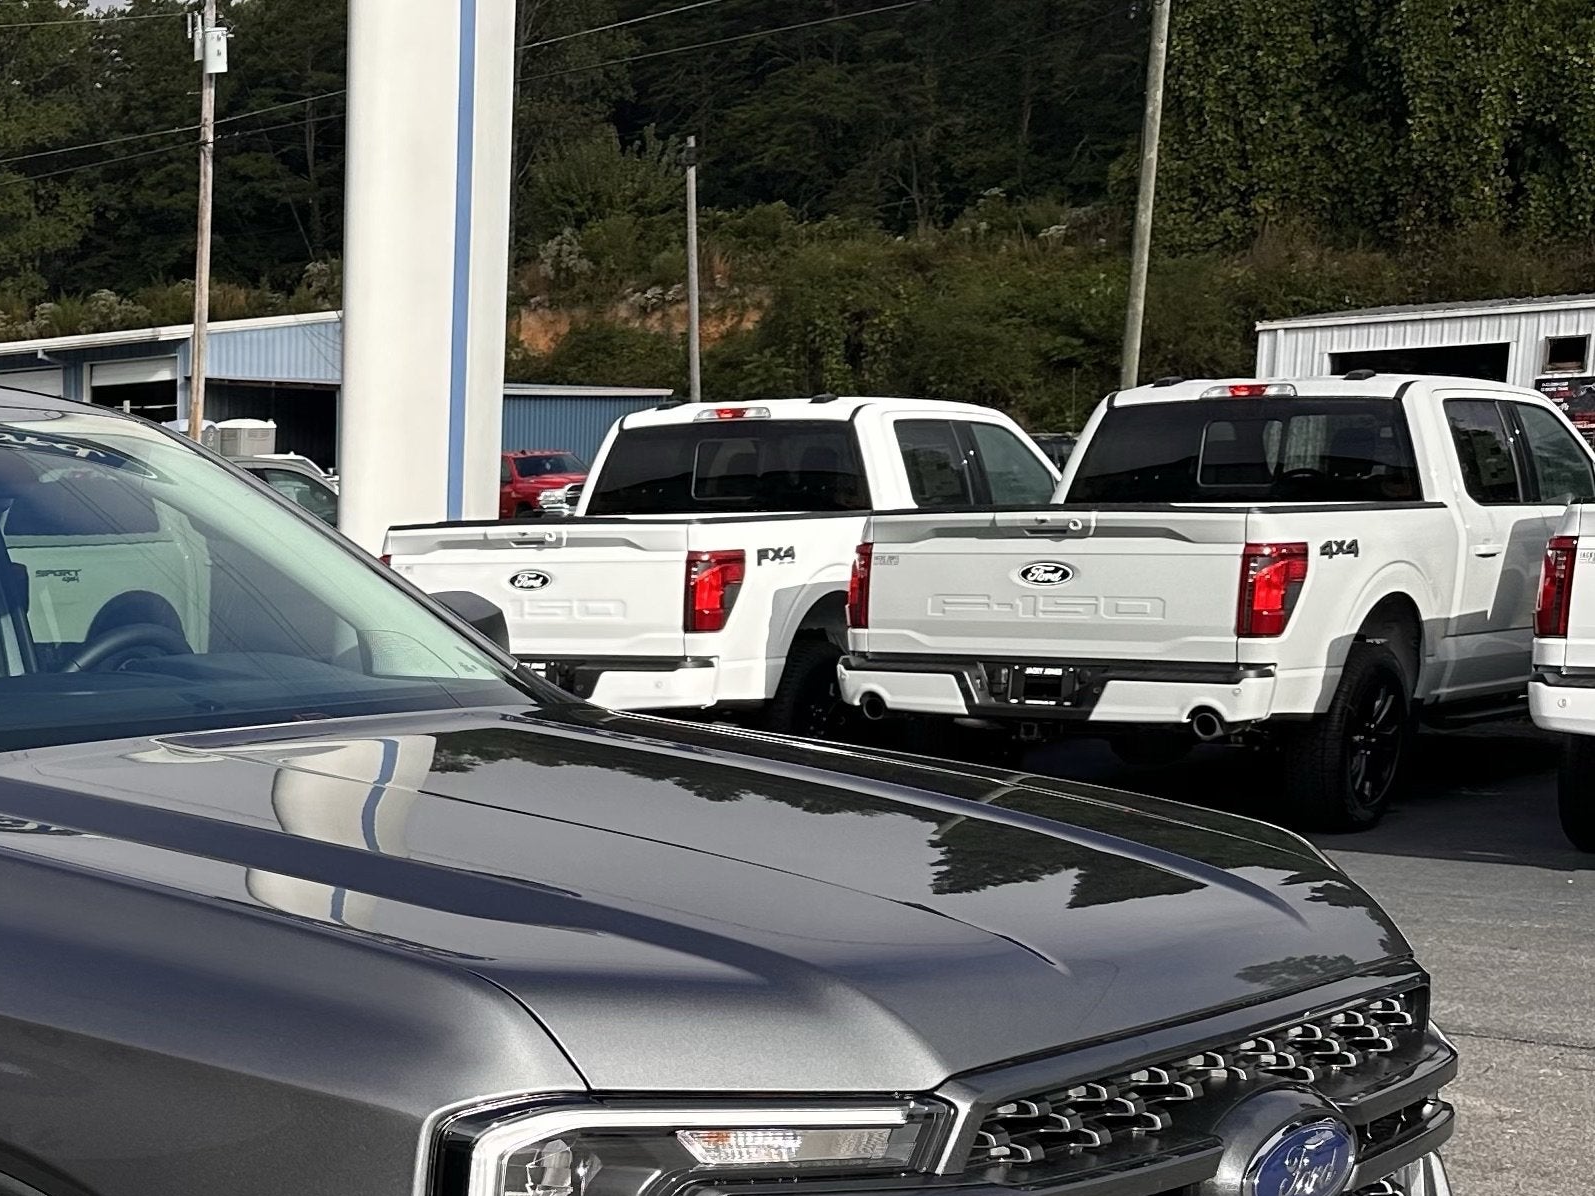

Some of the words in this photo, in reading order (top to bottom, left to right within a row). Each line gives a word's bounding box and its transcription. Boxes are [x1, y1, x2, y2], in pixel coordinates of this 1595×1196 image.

[757, 546, 796, 566] FX4
[35, 569, 83, 577] SPORT
[507, 599, 627, 620] 150
[927, 594, 1166, 620] F-150
